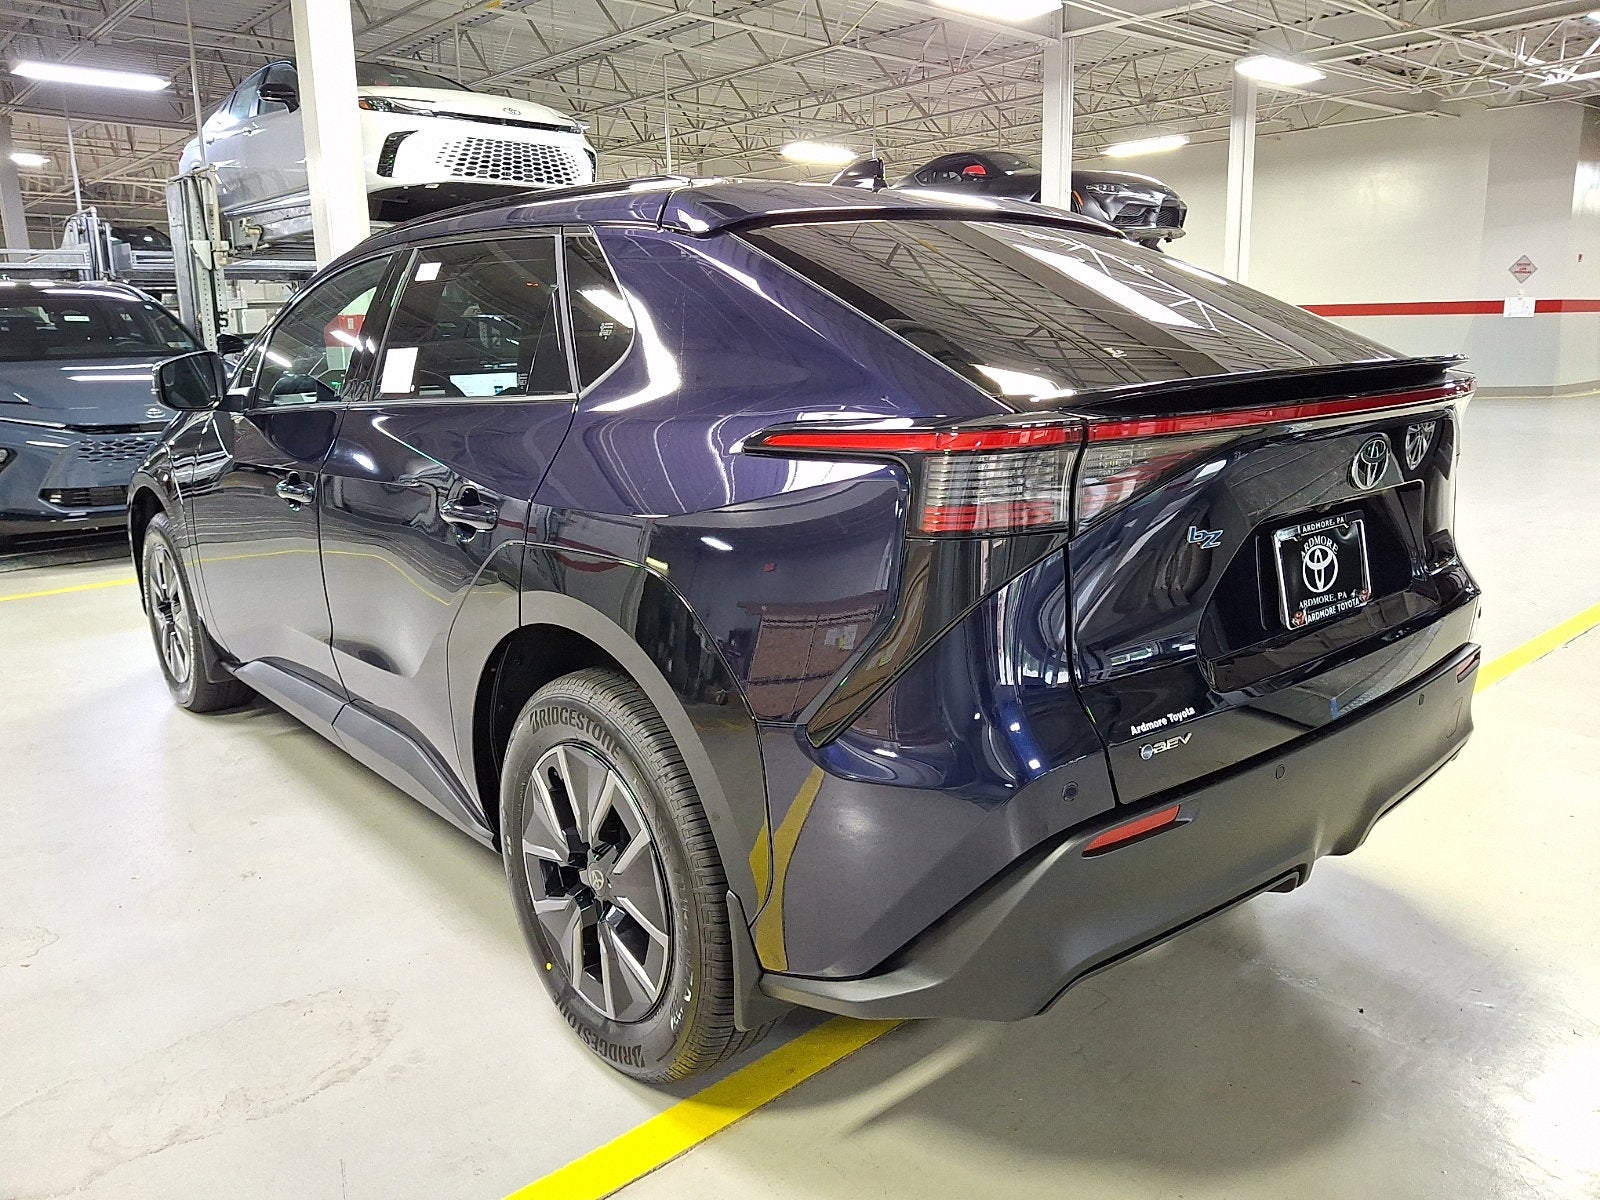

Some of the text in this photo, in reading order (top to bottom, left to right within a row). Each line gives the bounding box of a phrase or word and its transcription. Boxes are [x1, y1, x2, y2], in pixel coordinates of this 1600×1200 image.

[1336, 516, 1345, 524] PA
[1300, 535, 1339, 562] ARDMORE
[1337, 591, 1348, 600] PA
[1307, 597, 1360, 623] ARDMORE TOYOTA
[529, 706, 622, 761] BRIDGESTONE
[1130, 706, 1196, 736] Ardmore Toyota
